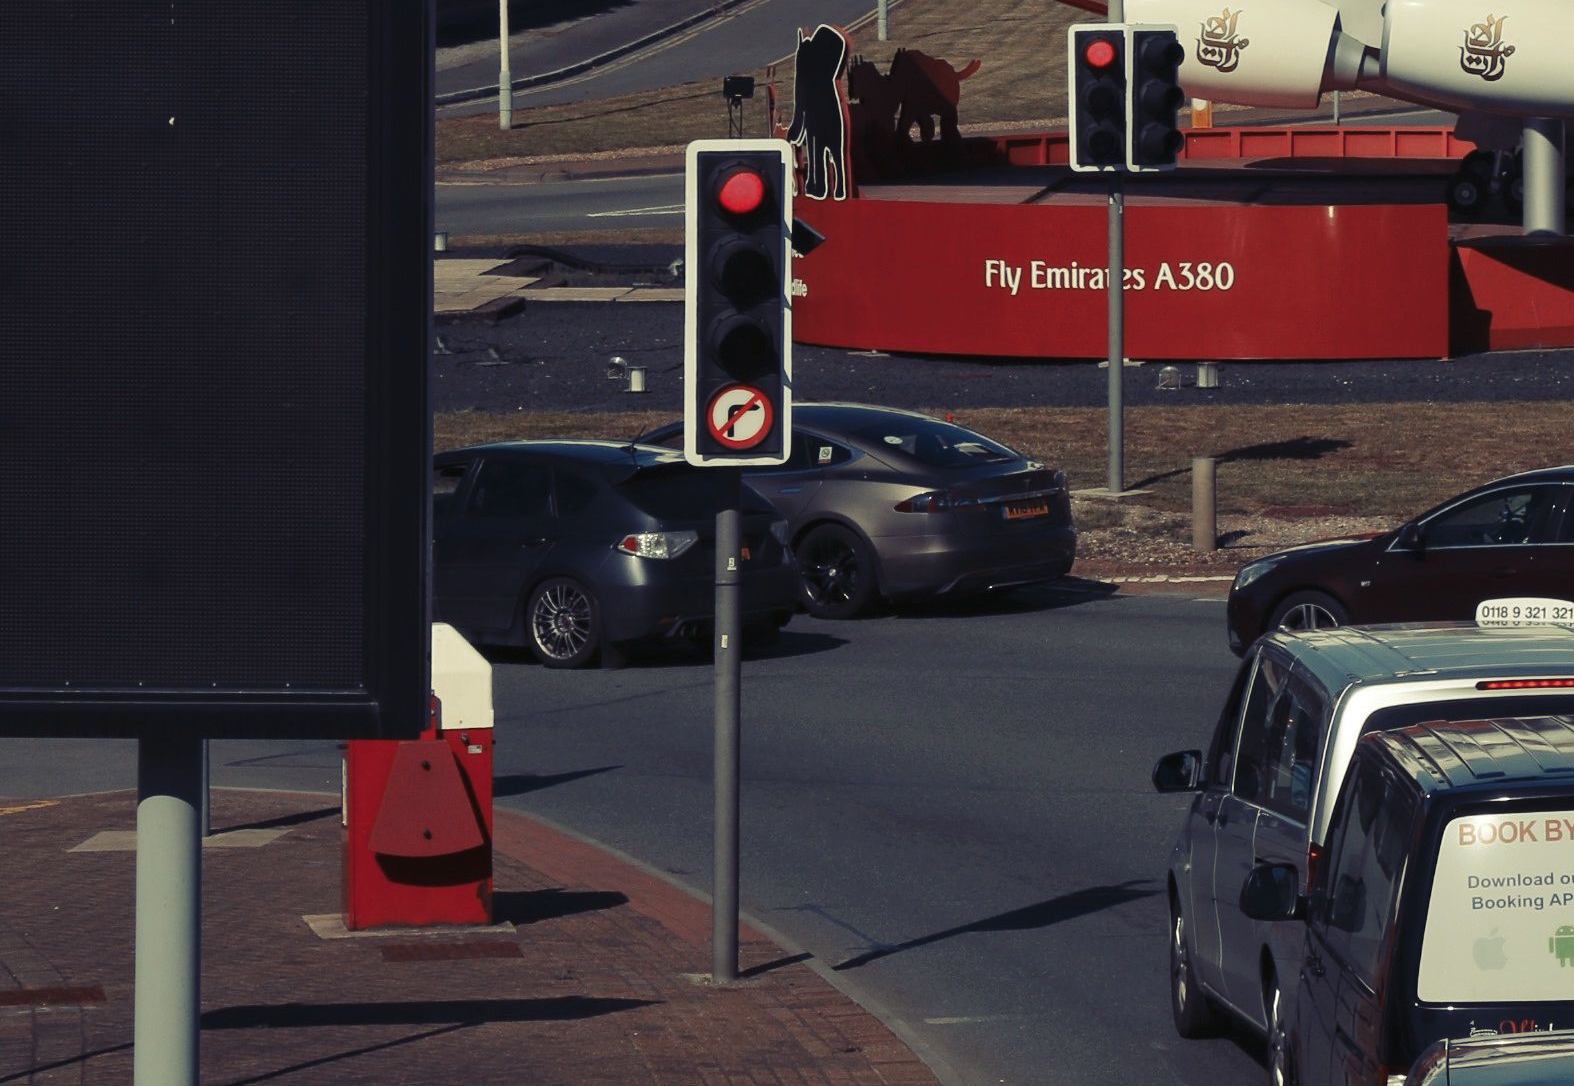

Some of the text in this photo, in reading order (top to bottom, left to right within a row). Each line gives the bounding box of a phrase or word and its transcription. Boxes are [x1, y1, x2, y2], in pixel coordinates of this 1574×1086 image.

[985, 260, 1235, 295] Fly Emiraes A380
[1481, 606, 1574, 619] 0118 9 321 321
[1458, 820, 1538, 846] BOOK
[1468, 873, 1555, 889] Download
[1471, 893, 1545, 911] Booking
